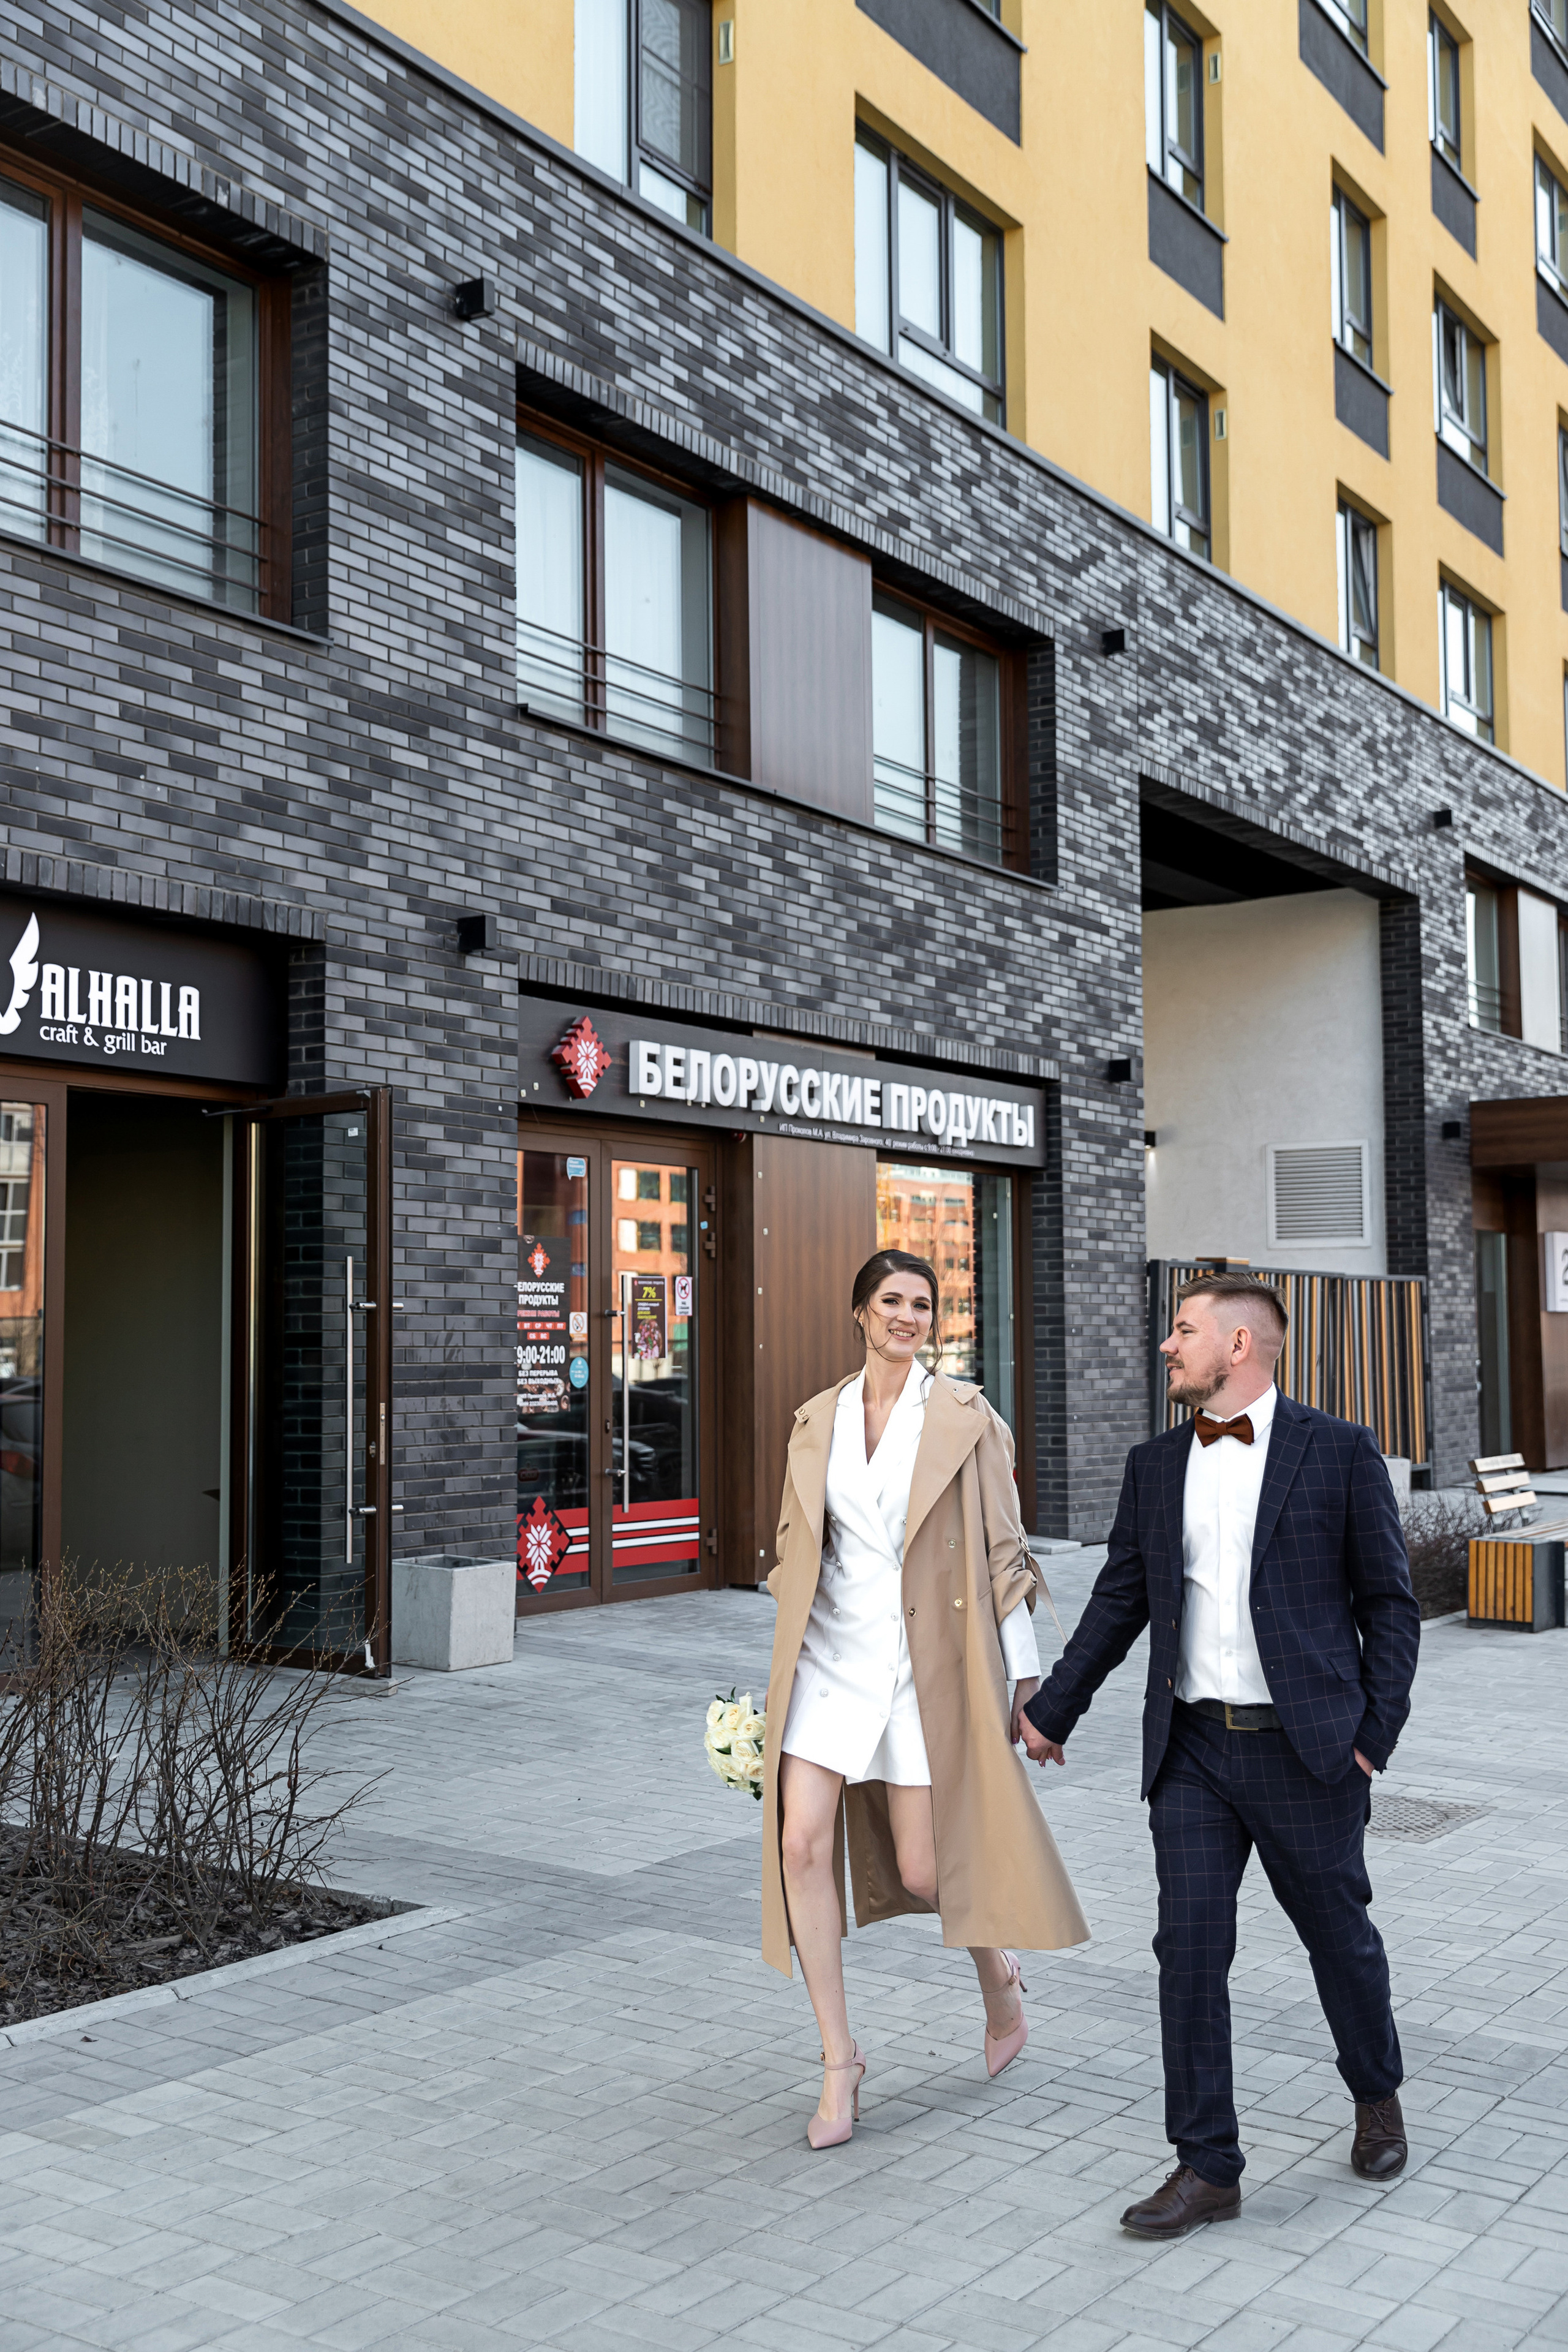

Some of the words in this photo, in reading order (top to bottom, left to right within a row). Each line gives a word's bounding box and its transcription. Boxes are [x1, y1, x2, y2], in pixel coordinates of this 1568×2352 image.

[40, 1023, 78, 1044] craft
[83, 1027, 100, 1047] &
[104, 1032, 135, 1055] grill
[141, 1034, 167, 1055] bar
[630, 1040, 881, 1128] БЕЛОРУССКИЕ
[883, 1082, 1035, 1148] ПРОДУКТЫ
[778, 1123, 787, 1132] ИП
[832, 1130, 858, 1144] Владимира
[892, 1140, 907, 1148] режим
[908, 1141, 924, 1151] работы
[517, 1281, 565, 1293] ЕЛОРУССКИЕ
[642, 1286, 657, 1298] 7%
[518, 1294, 559, 1306] ПРОДУКТЫ
